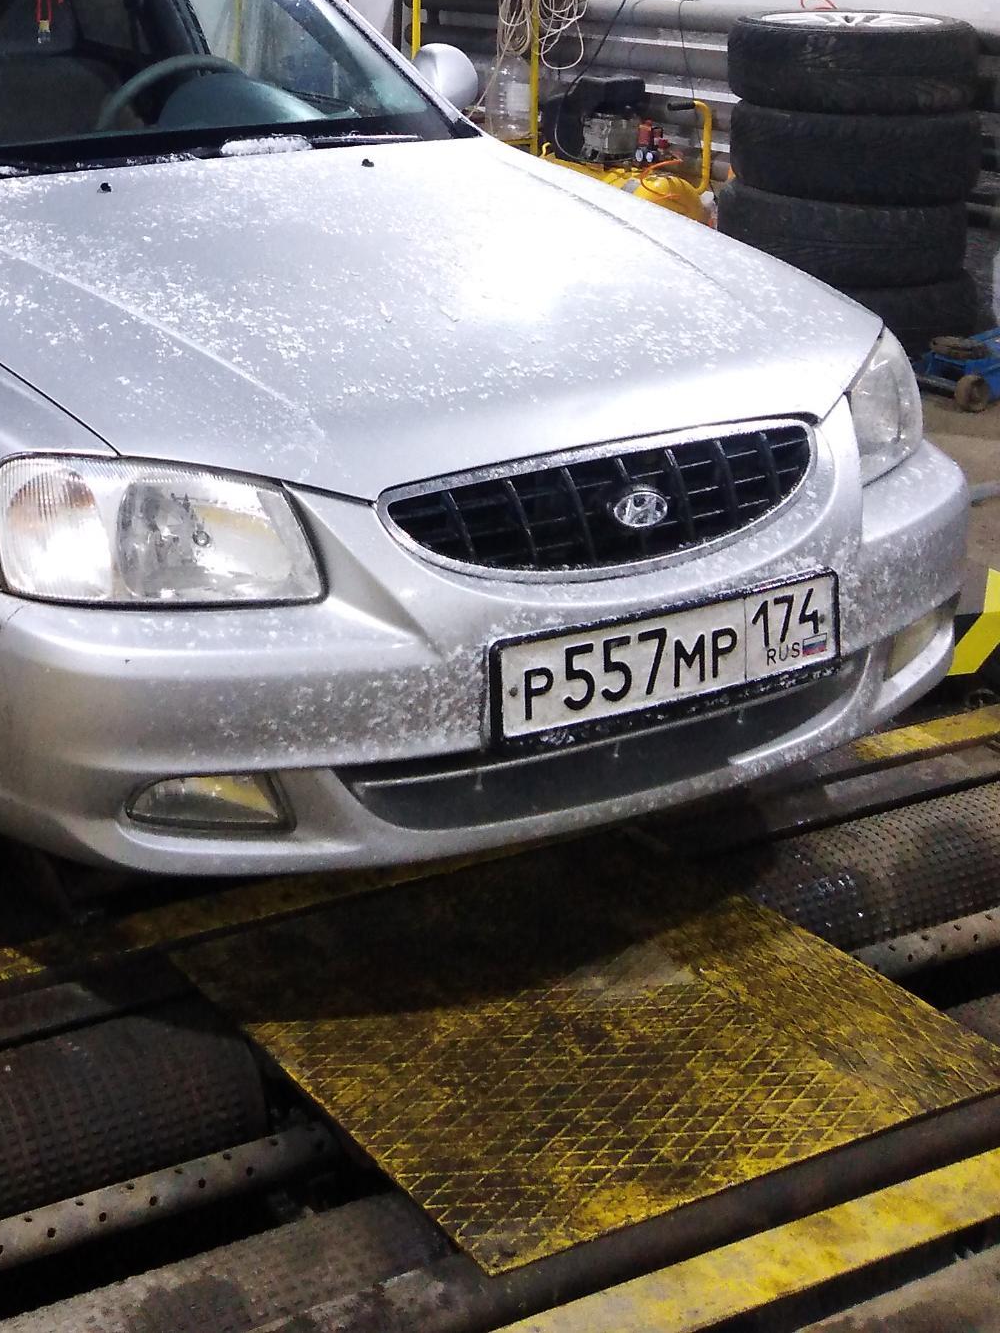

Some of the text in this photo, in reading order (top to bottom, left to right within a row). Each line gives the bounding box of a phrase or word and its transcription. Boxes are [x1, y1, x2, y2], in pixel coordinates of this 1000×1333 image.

[523, 587, 820, 721] P557MP 174
[766, 641, 801, 667] RUS
